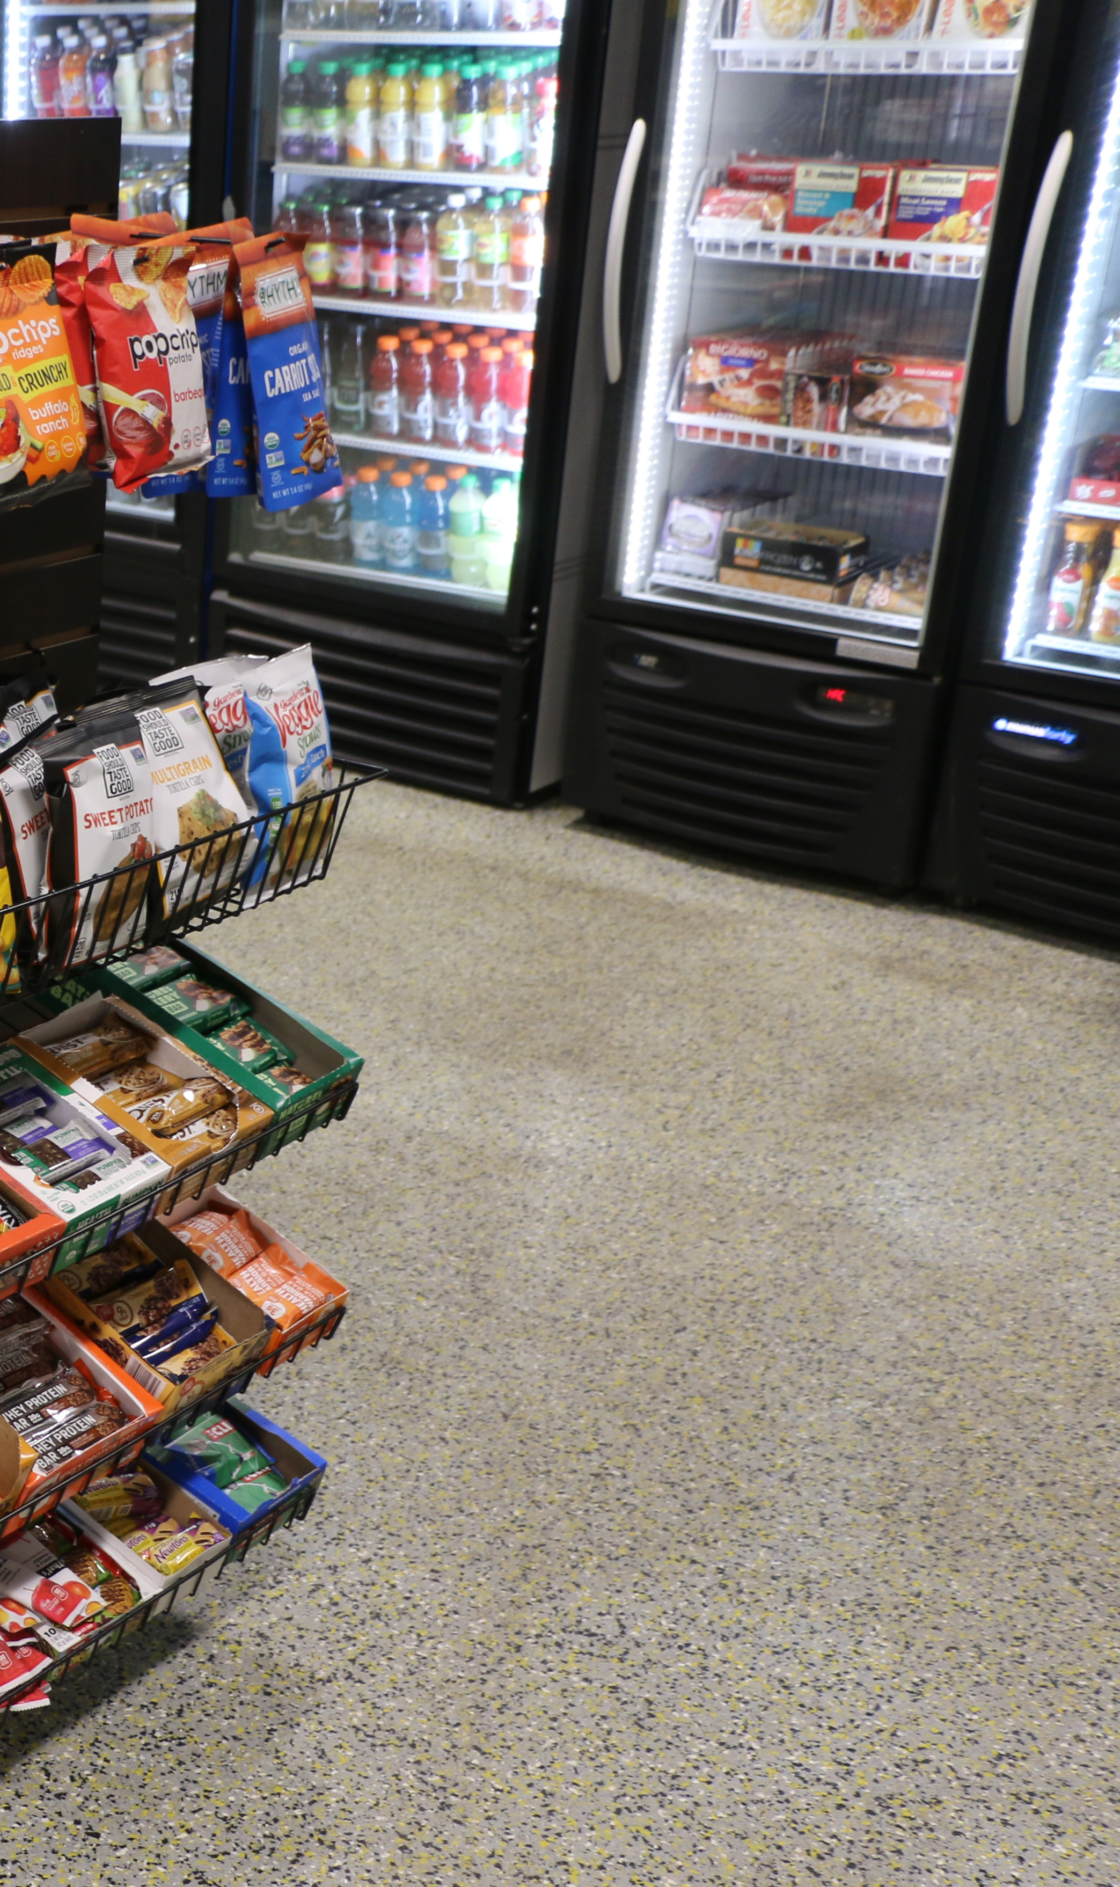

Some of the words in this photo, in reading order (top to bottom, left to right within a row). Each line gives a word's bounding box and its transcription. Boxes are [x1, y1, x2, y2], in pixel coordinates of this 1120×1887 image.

[12, 343, 45, 361] ridges
[168, 353, 193, 368] potato
[18, 360, 70, 395] CRUNCHY
[264, 359, 310, 399] CARROT
[28, 399, 70, 421] buffalo
[35, 416, 70, 436] ranch
[142, 720, 169, 733] SHOULD
[267, 687, 323, 749] Veggie
[147, 728, 175, 742] TASTE
[96, 747, 120, 761] FOOD
[153, 738, 180, 753] GOOD
[105, 758, 125, 771] SHOULD
[151, 755, 213, 785] MULTIGRAIN
[107, 766, 129, 783] TASTE
[110, 779, 133, 795] GOOD
[84, 808, 124, 829] SWEET
[27, 1383, 68, 1411] PROTEIN
[54, 1414, 97, 1444] PROTEIN
[36, 1452, 60, 1470] BAR
[144, 1521, 157, 1532] Fig
[154, 1534, 189, 1564] Newtons
[43, 1627, 57, 1638] 10
